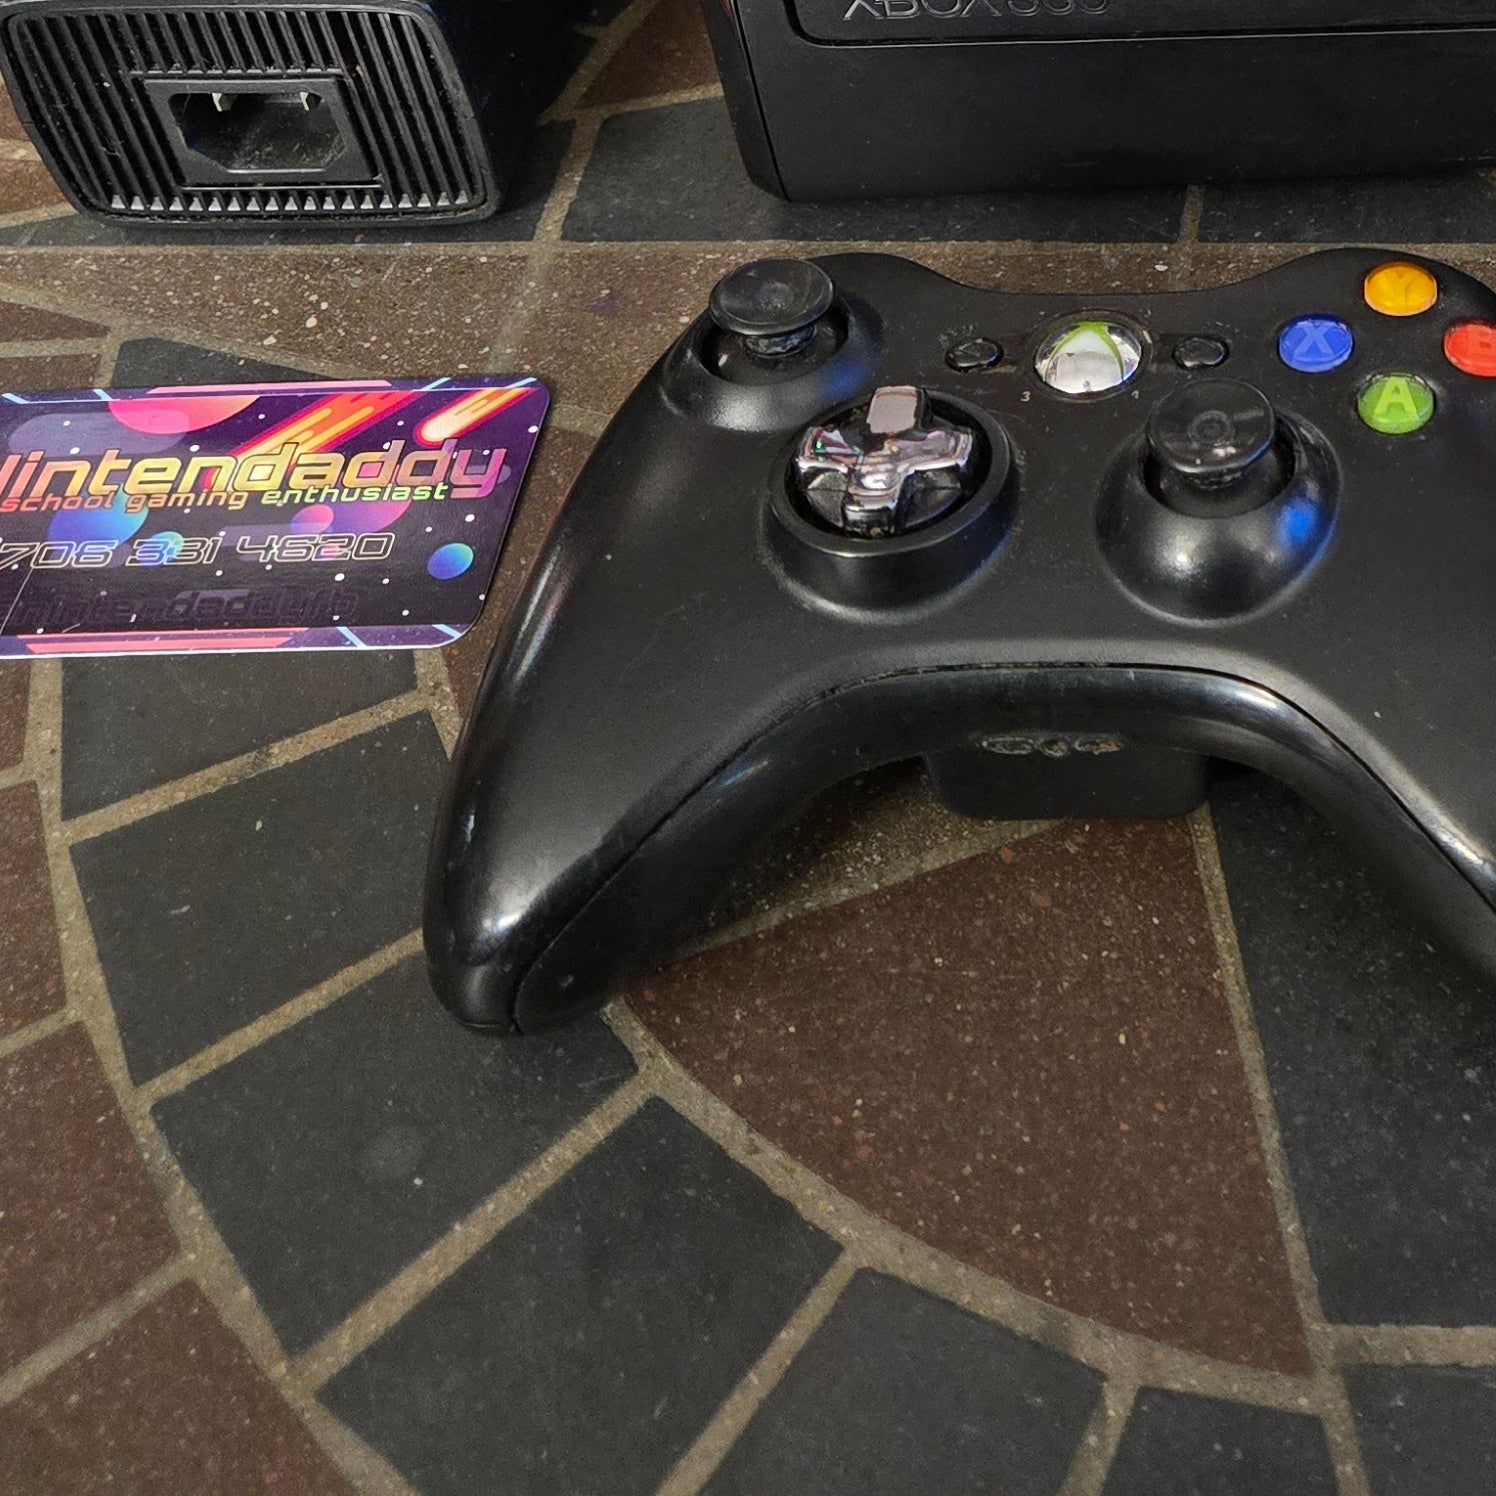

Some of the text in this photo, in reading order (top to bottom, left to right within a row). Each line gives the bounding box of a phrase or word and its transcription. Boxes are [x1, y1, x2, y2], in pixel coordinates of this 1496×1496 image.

[1373, 377, 1419, 417] A
[124, 490, 249, 514] gaming
[261, 481, 448, 505] enthusiast
[236, 531, 396, 564] 4620
